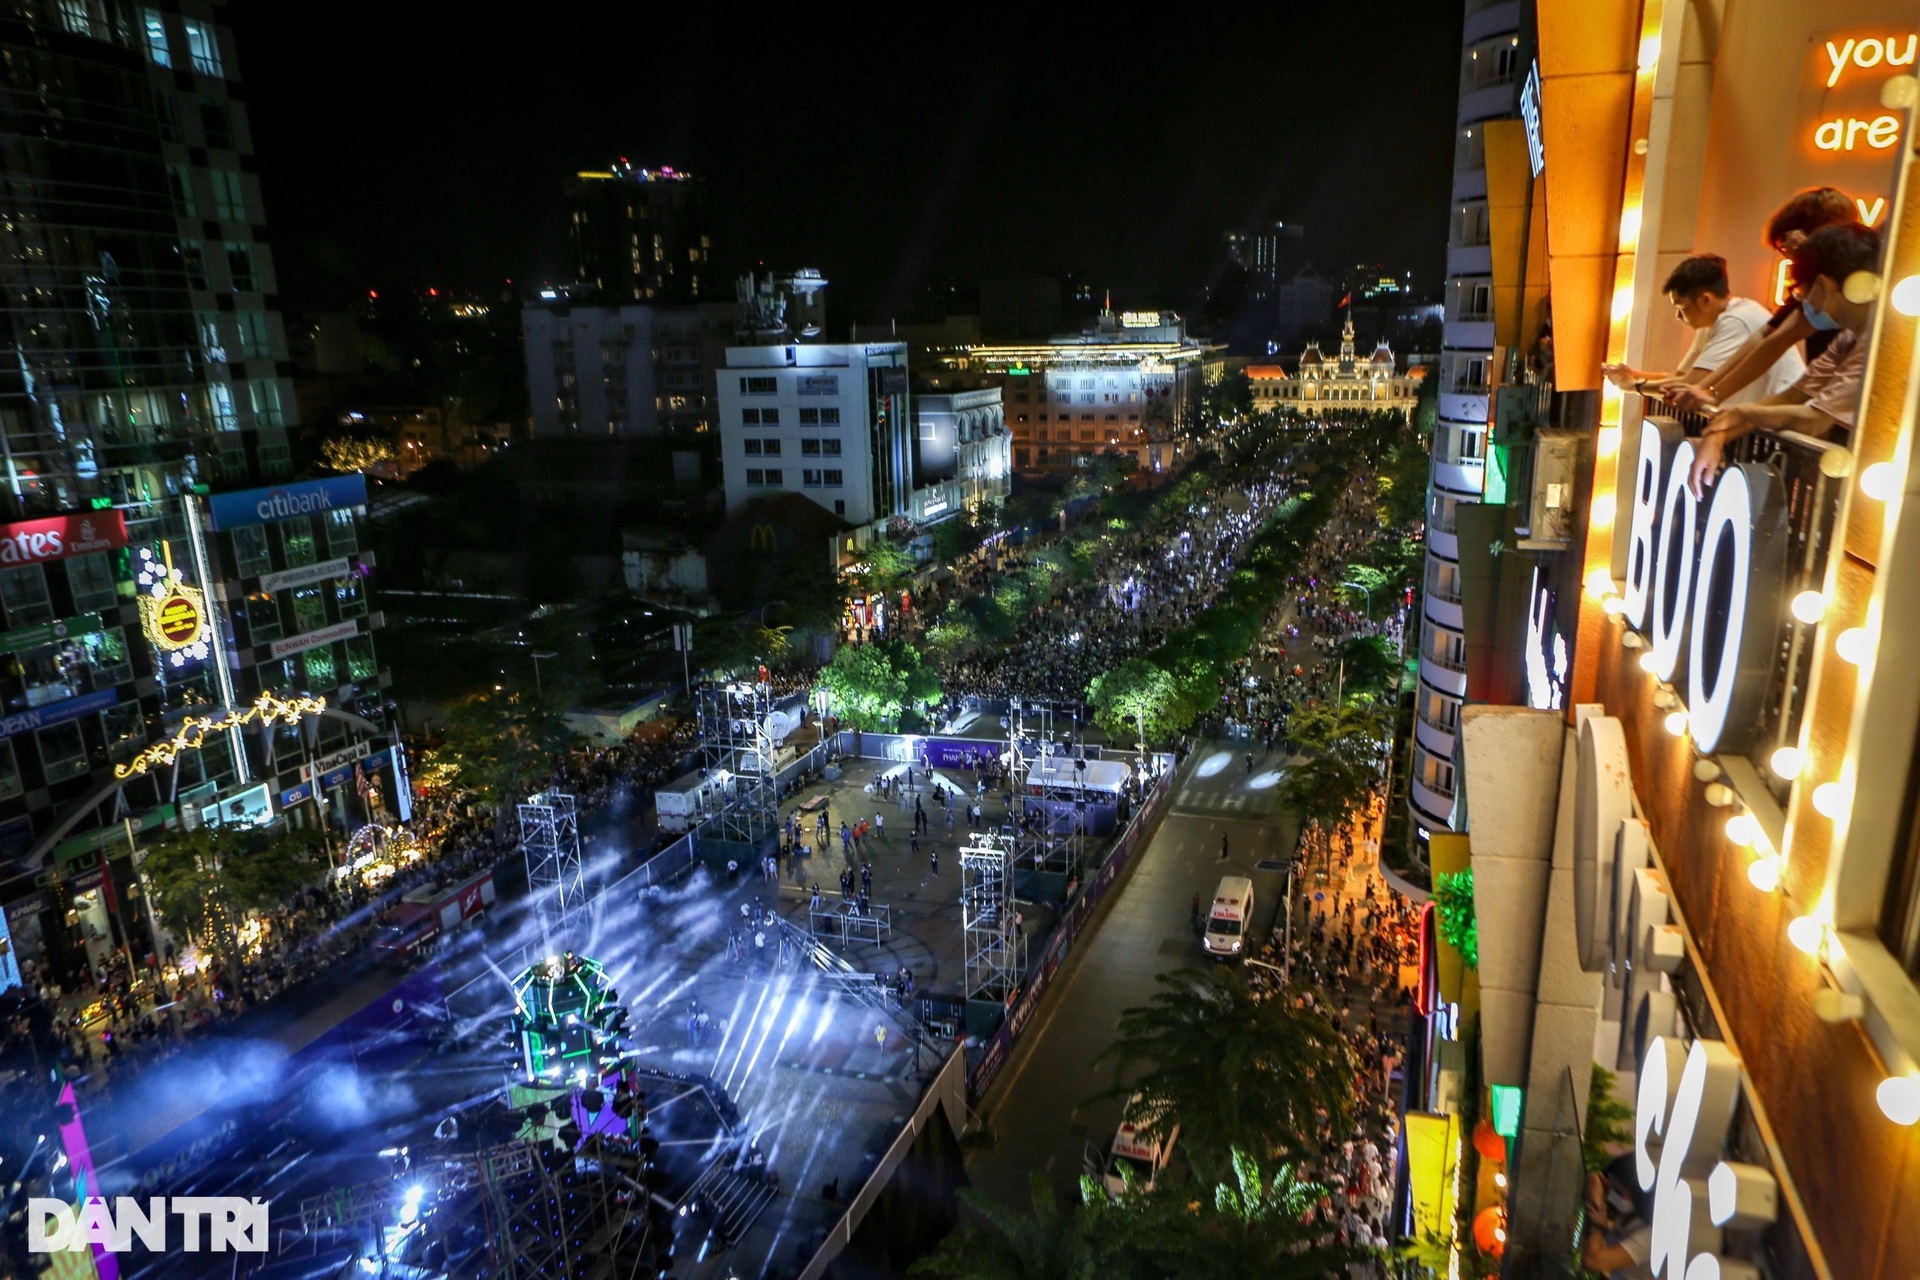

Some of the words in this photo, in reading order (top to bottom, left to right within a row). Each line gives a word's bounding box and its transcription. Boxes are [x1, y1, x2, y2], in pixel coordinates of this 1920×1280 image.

[1826, 34, 1918, 88] you
[1814, 115, 1900, 151] are
[256, 487, 333, 521] citibank
[1622, 416, 1751, 755] BOO
[288, 789, 303, 805] citi
[10, 900, 42, 920] KPMG
